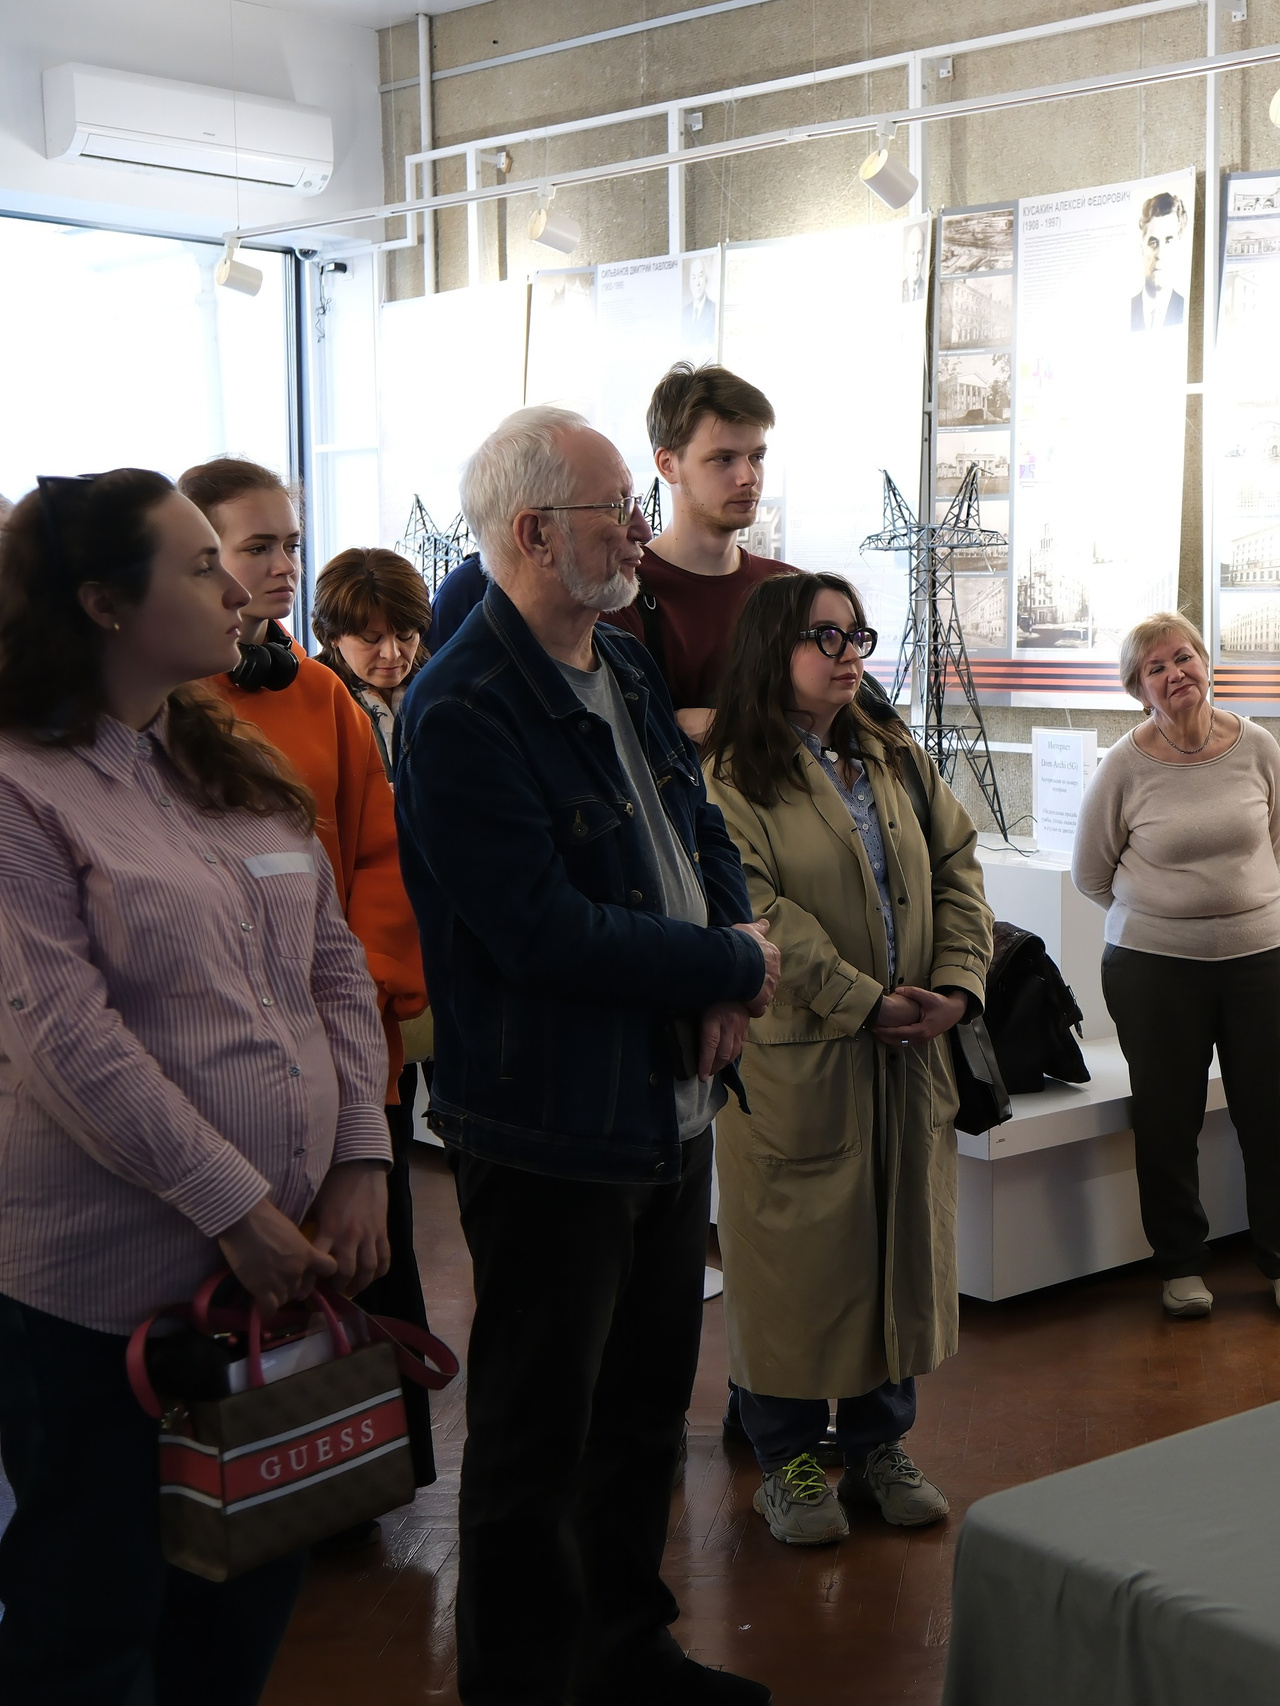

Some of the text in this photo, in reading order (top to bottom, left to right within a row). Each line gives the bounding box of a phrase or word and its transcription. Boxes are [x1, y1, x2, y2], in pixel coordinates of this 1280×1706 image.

[1022, 191, 1131, 217] КУСАКИН АЛЕКСЕЙ ФЕДОРОВИЧ
[1041, 758, 1053, 768] Dom
[260, 1419, 375, 1480] GUESS
